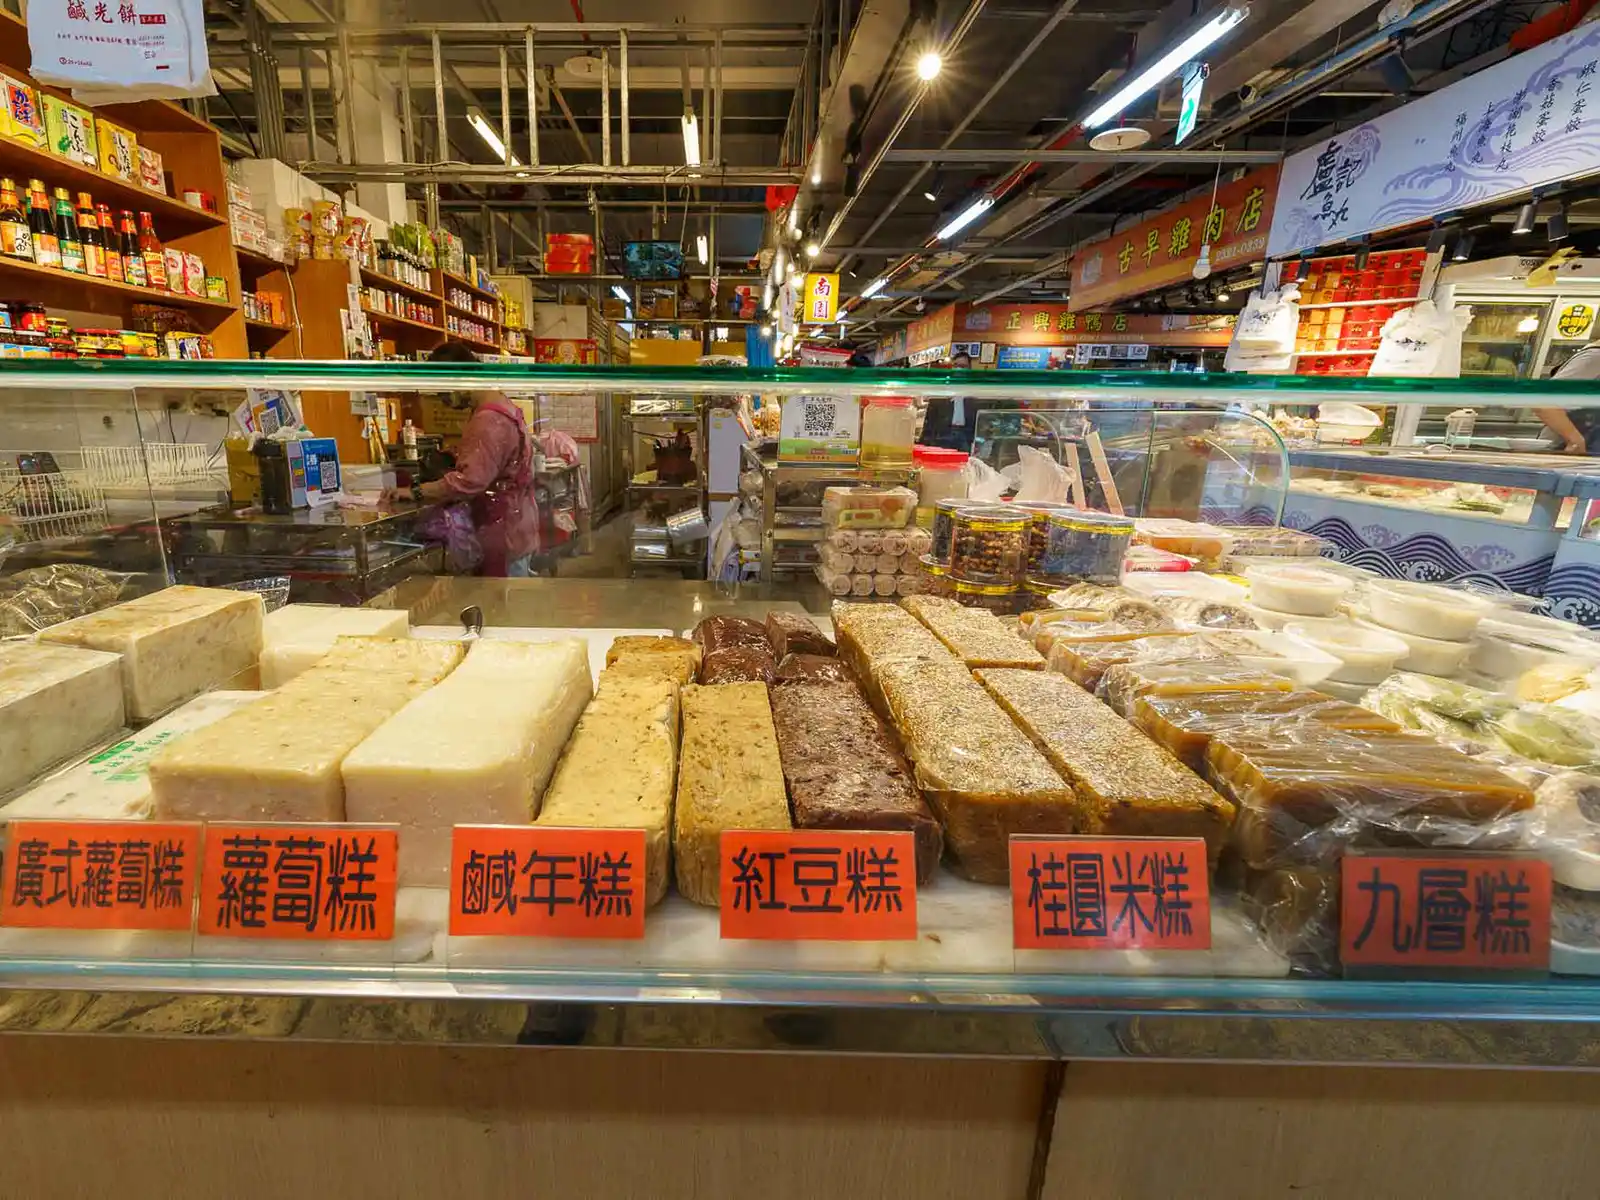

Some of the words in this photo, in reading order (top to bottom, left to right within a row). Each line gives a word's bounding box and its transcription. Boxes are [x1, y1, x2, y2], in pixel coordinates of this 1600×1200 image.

[67, 0, 137, 25] 鹹光餅
[1119, 188, 1264, 274] 古早雞肉店
[1006, 311, 1127, 332] 正興雞鴨店
[12, 838, 184, 910] 廣式蘿蔔糕
[217, 836, 378, 932] 蘿蔔糕
[462, 849, 633, 918] 鹹年糕
[732, 847, 903, 914] 紅豆糕
[1027, 851, 1193, 939] 桂圓米糕
[1353, 867, 1531, 954] 九層糕
